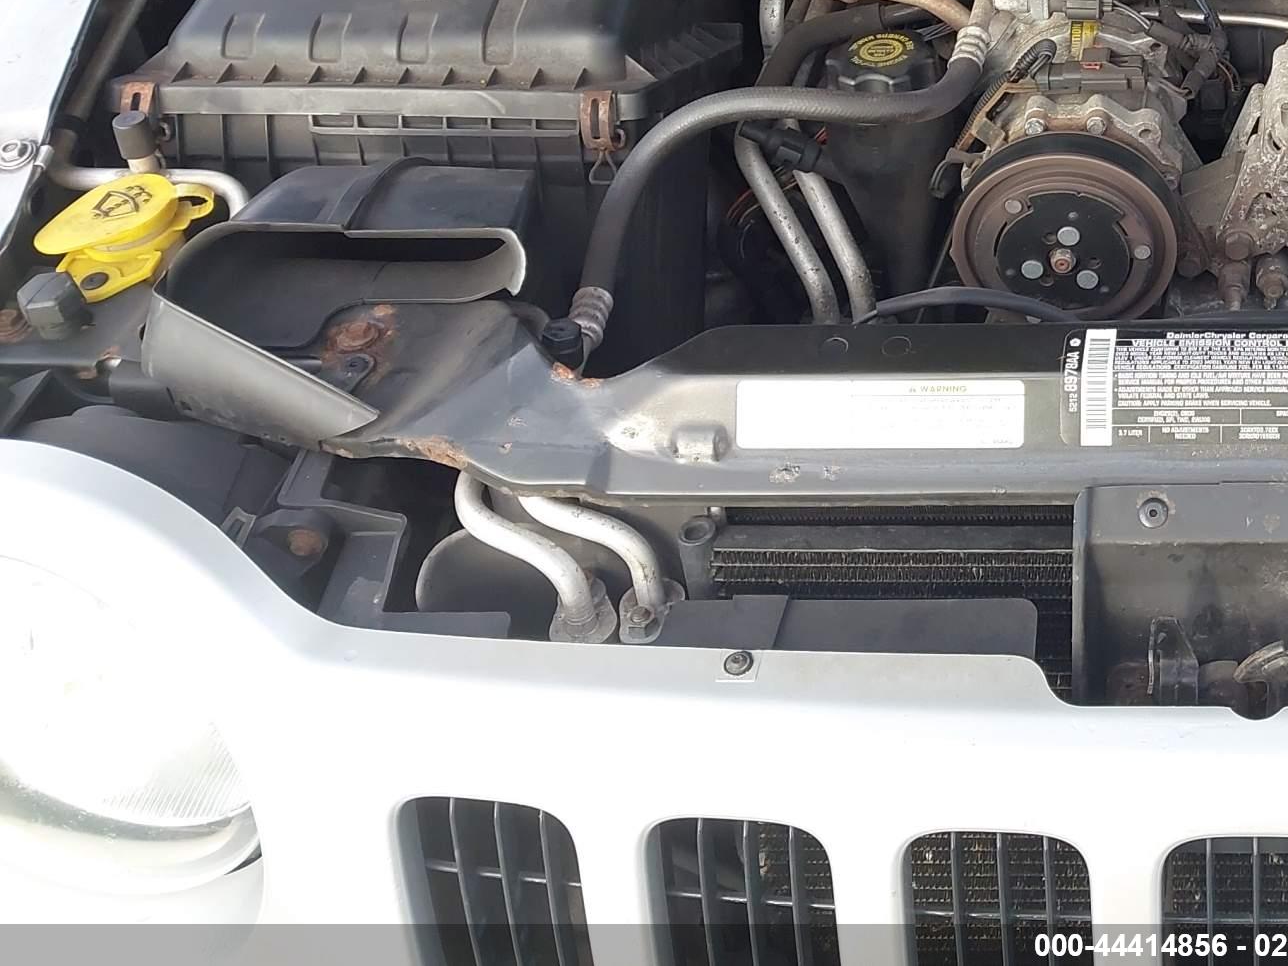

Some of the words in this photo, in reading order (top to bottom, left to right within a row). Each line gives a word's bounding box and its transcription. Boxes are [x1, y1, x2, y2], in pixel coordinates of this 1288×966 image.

[1166, 332, 1246, 341] DaimlerChrysler
[1132, 339, 1175, 347] VEHICLE
[1178, 339, 1231, 347] EMISSION
[1234, 339, 1282, 347] CONTROL
[1064, 351, 1080, 392] 8978AA
[920, 385, 968, 393] WARNING
